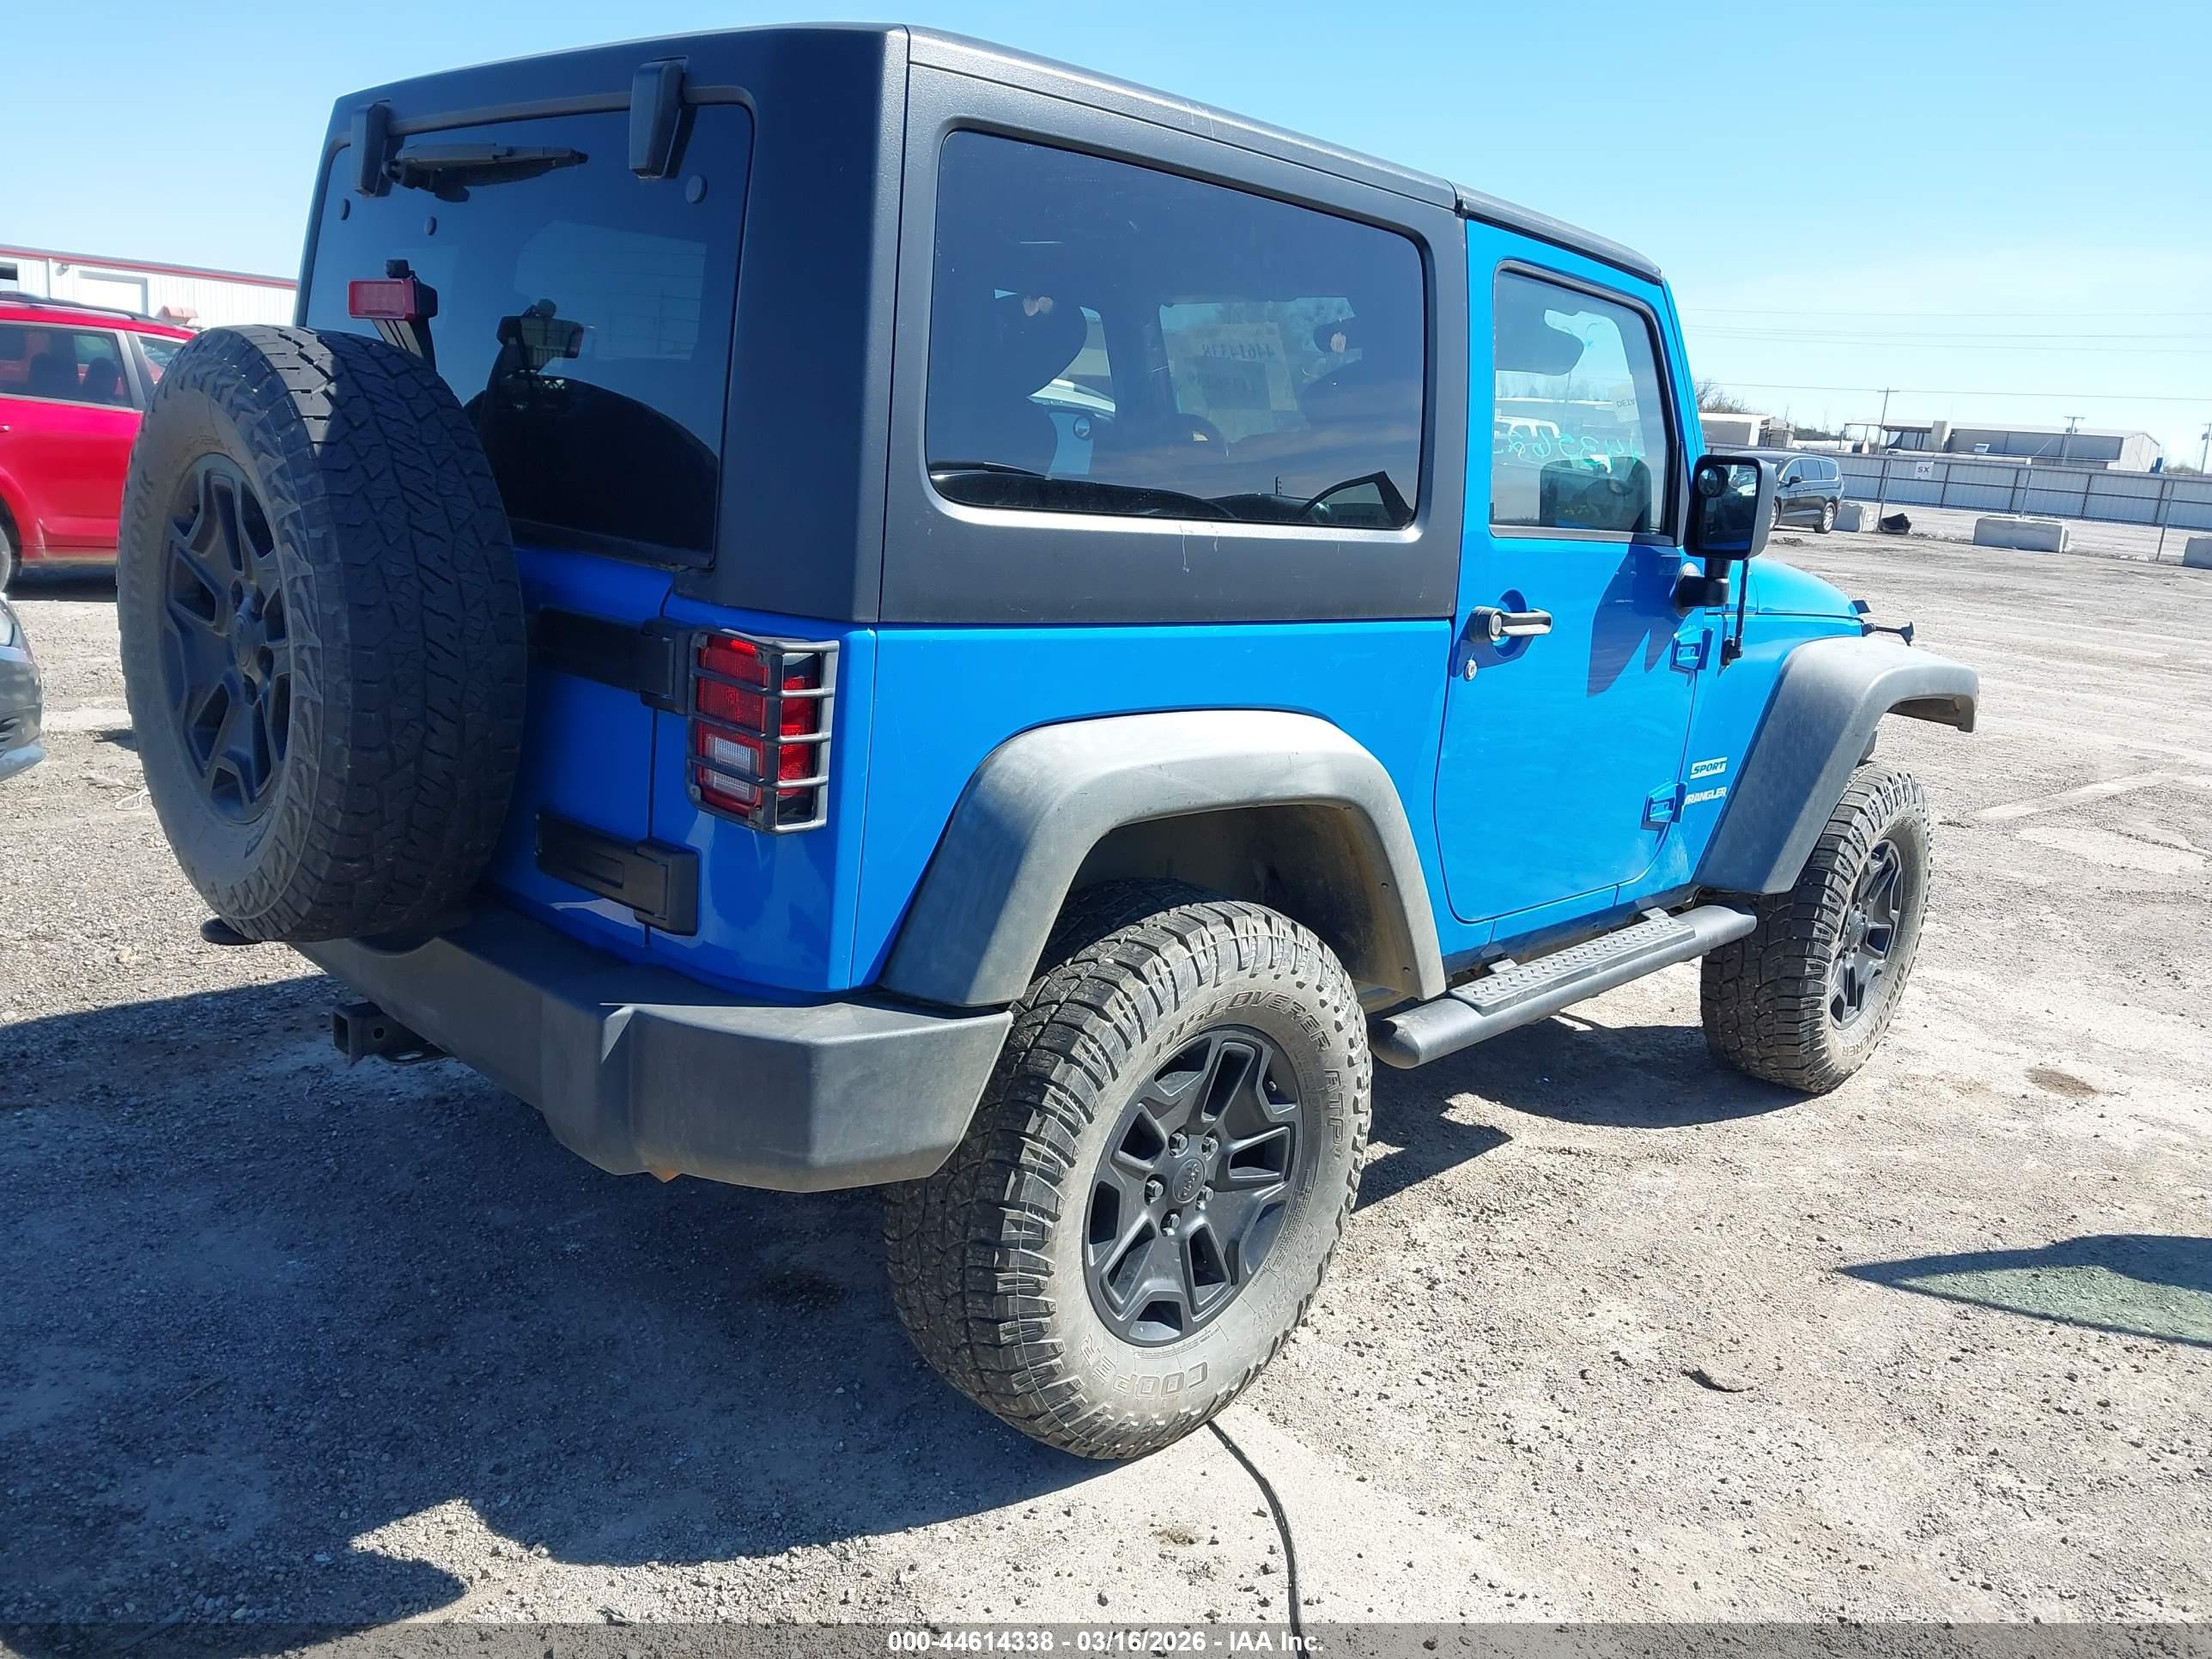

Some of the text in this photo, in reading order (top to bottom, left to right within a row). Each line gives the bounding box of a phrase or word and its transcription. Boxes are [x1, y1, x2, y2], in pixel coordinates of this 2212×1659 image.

[1693, 761, 1725, 775] SPORT
[1152, 990, 1331, 1061] DISCOVERER
[1842, 963, 1905, 1057] DISCOVERER
[1080, 1332, 1208, 1398] COOPER
